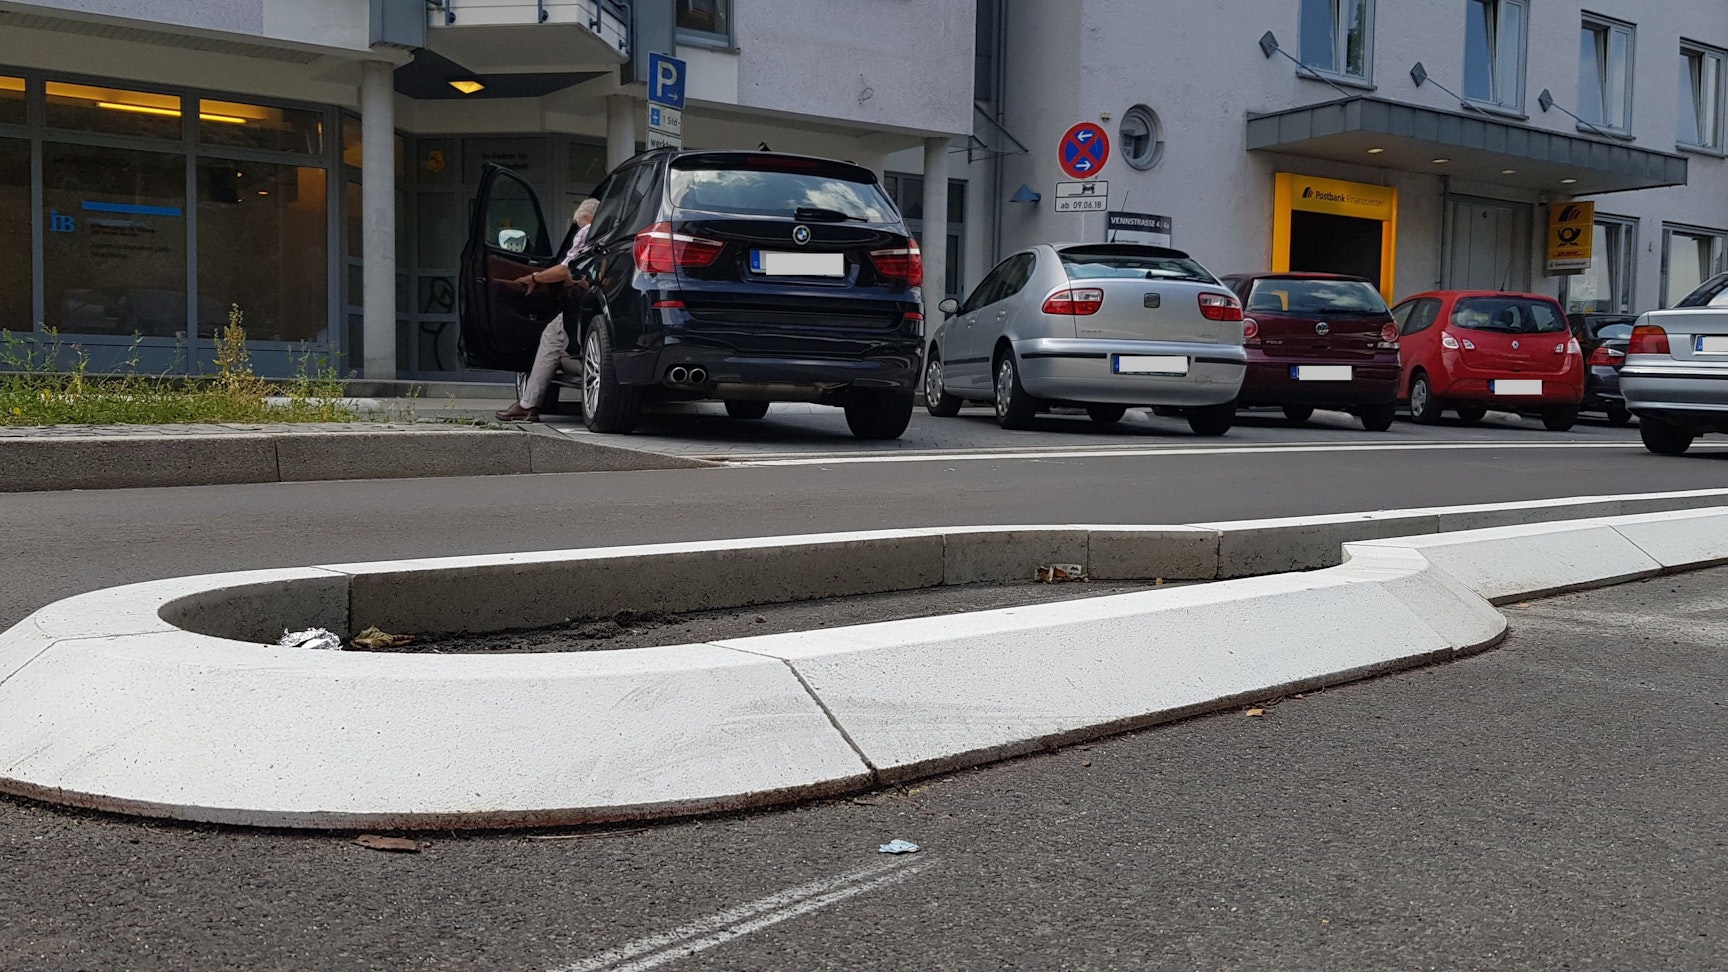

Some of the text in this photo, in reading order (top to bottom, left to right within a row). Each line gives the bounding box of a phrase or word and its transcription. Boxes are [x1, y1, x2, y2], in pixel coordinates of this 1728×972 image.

[656, 60, 678, 97] P
[1315, 190, 1346, 203] Postbank
[1060, 201, 1102, 209] ab 09.06.18
[1110, 216, 1156, 228] VENNSTRASSE
